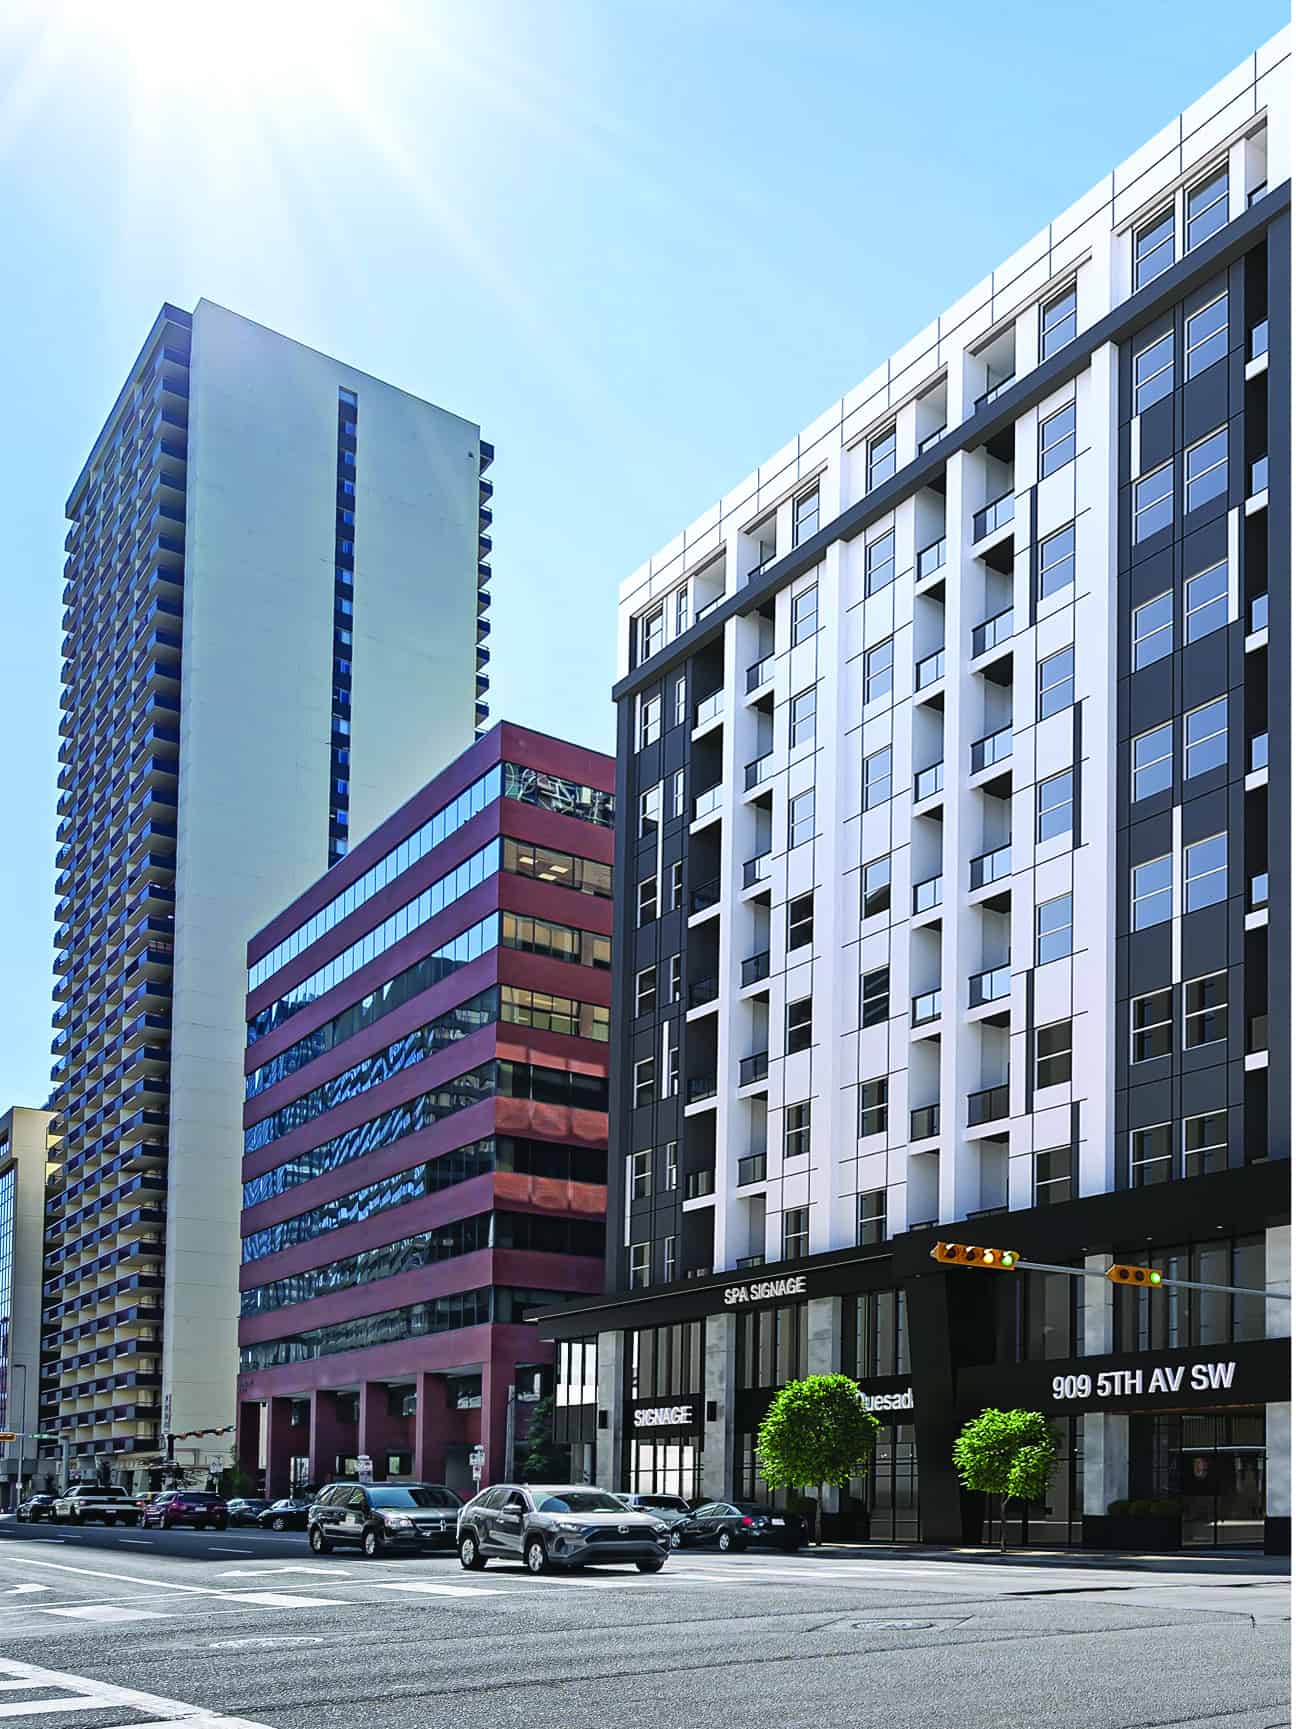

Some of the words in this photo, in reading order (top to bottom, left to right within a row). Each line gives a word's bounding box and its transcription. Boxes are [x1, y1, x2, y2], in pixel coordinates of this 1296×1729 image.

[724, 1286, 750, 1305] SPA
[750, 1275, 807, 1301] SIGNAGE
[1052, 1374, 1092, 1400] 909
[1096, 1370, 1143, 1397] 5TH
[1148, 1366, 1186, 1393] AV
[1190, 1361, 1236, 1391] SW
[633, 1405, 693, 1427] SIGNAGE
